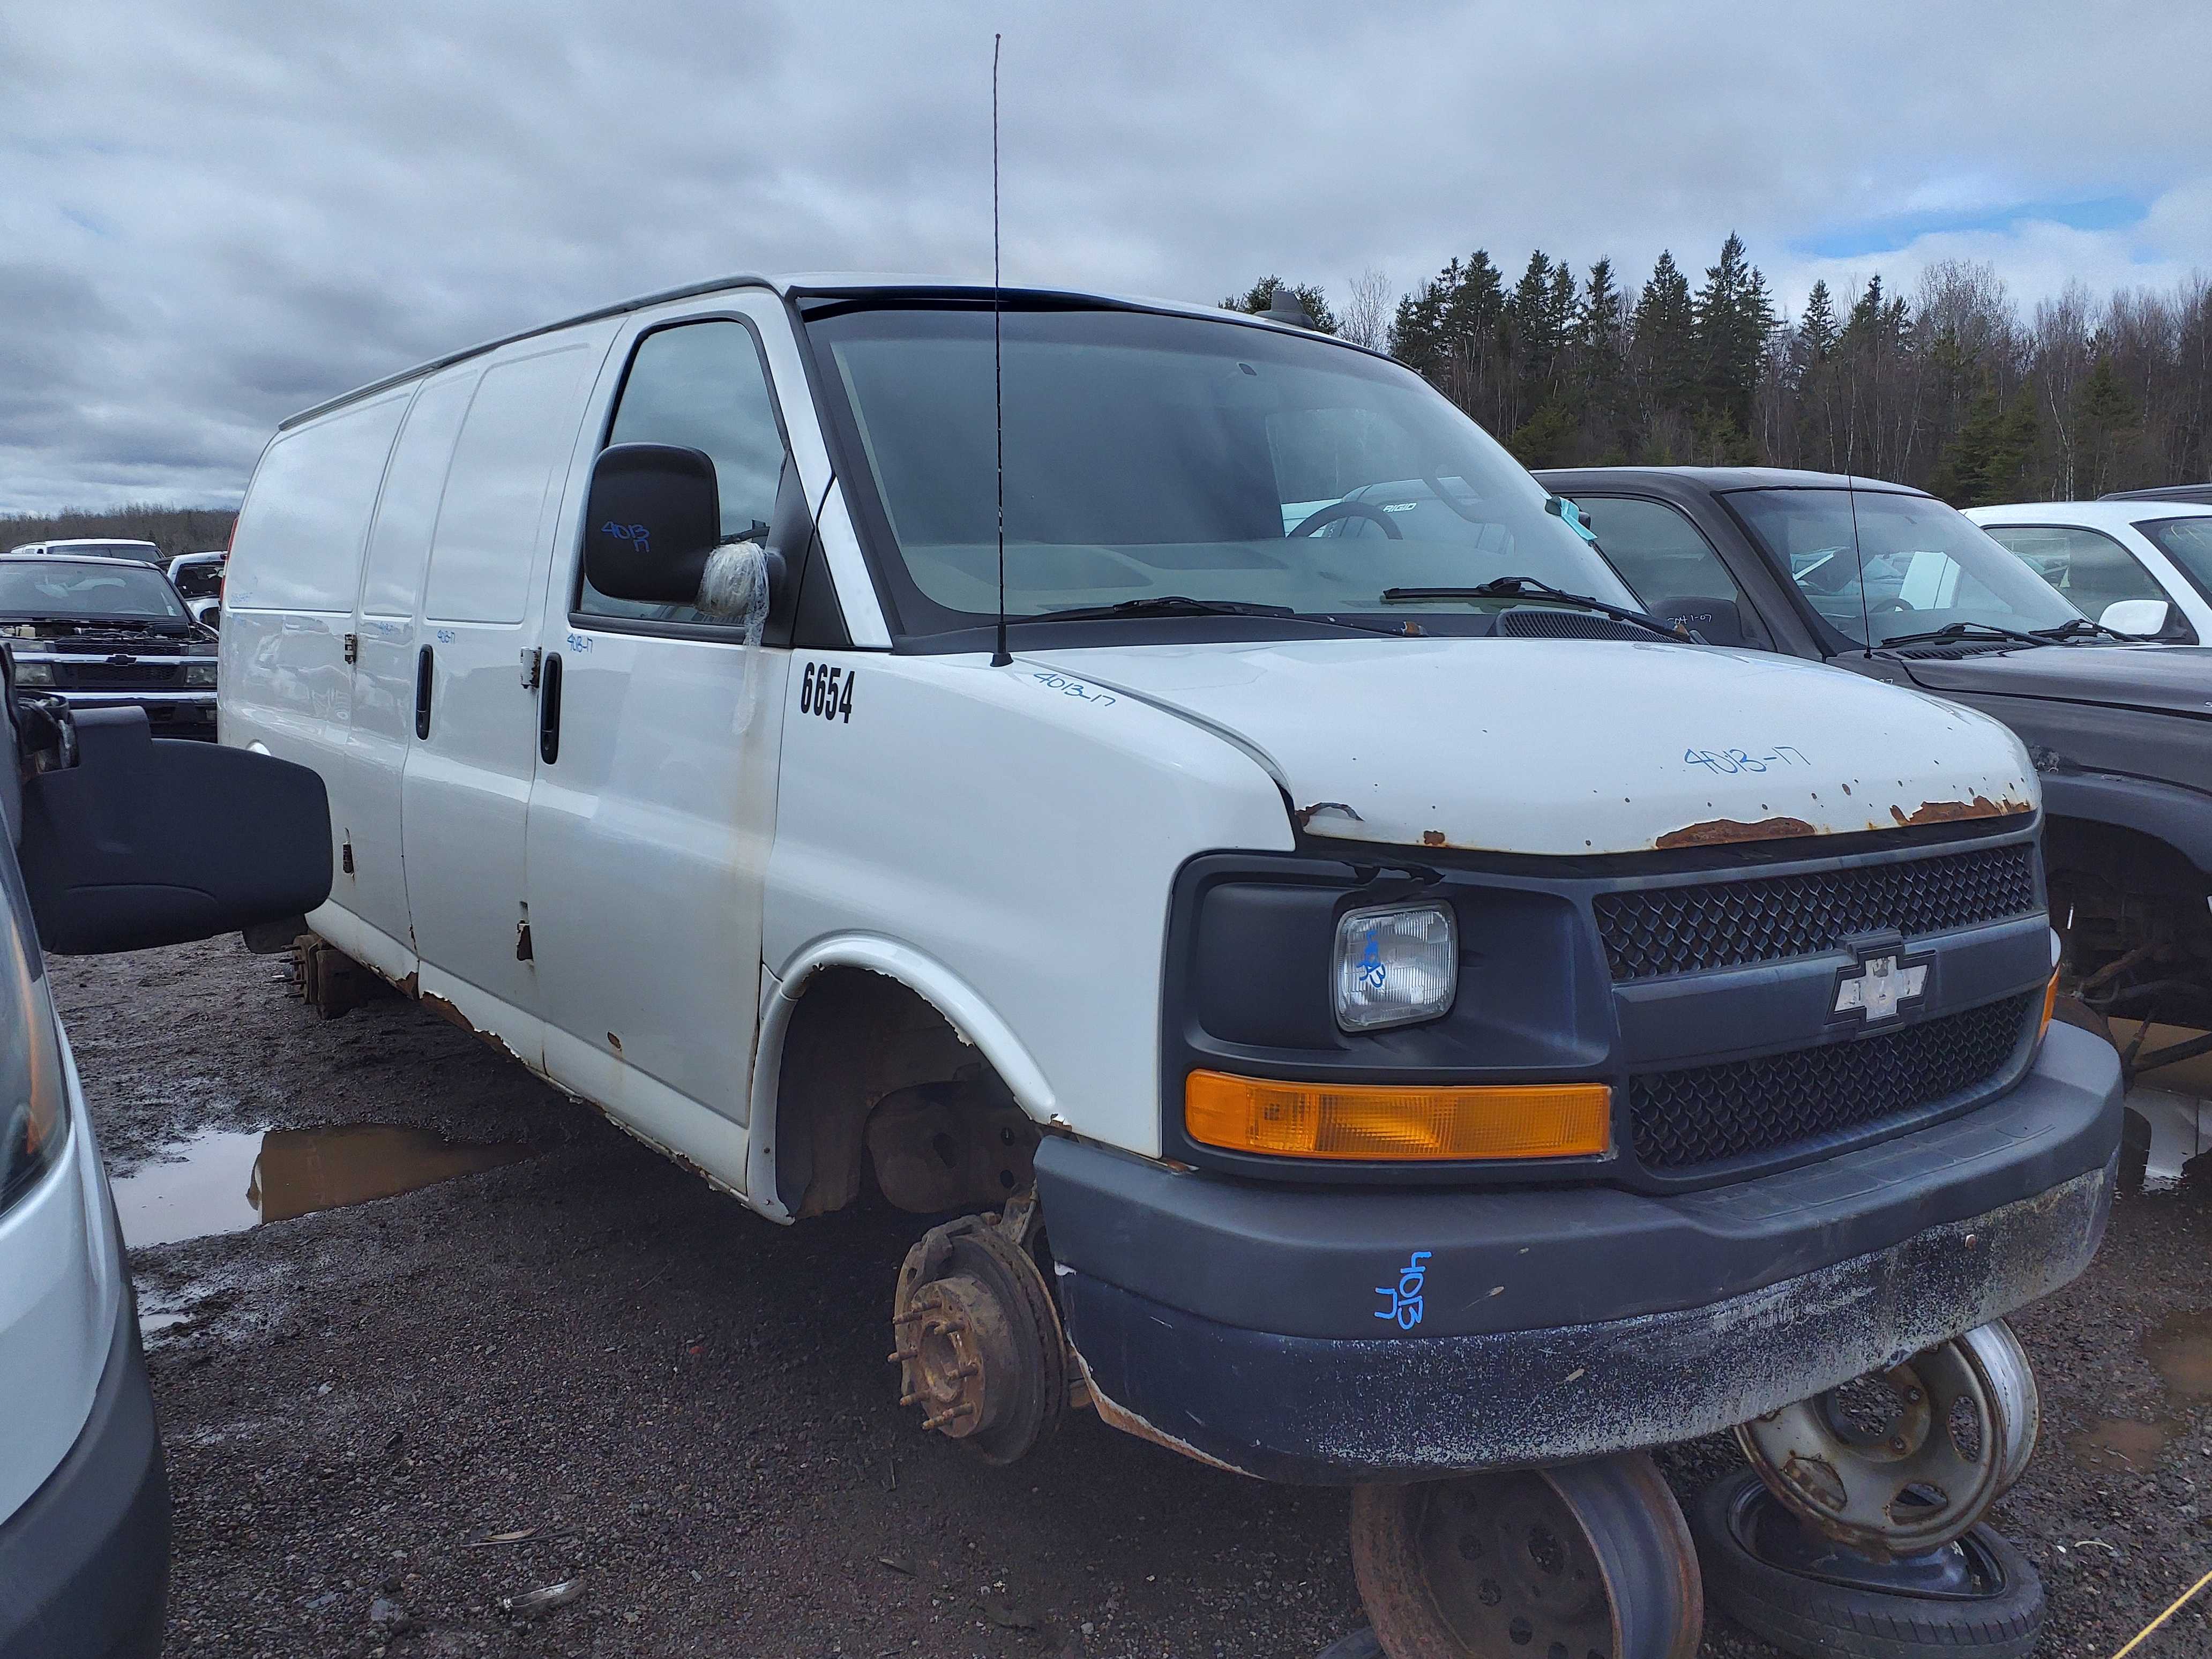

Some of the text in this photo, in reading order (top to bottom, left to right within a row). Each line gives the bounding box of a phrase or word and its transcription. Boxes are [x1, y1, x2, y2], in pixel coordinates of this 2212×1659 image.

[1382, 502, 1417, 513] RIGID
[600, 520, 651, 541] 4013
[801, 662, 855, 723] 6654
[1033, 673, 1116, 707] 4013-17
[1684, 746, 1811, 774] 4013-17
[1397, 1251, 1432, 1330] 4013
